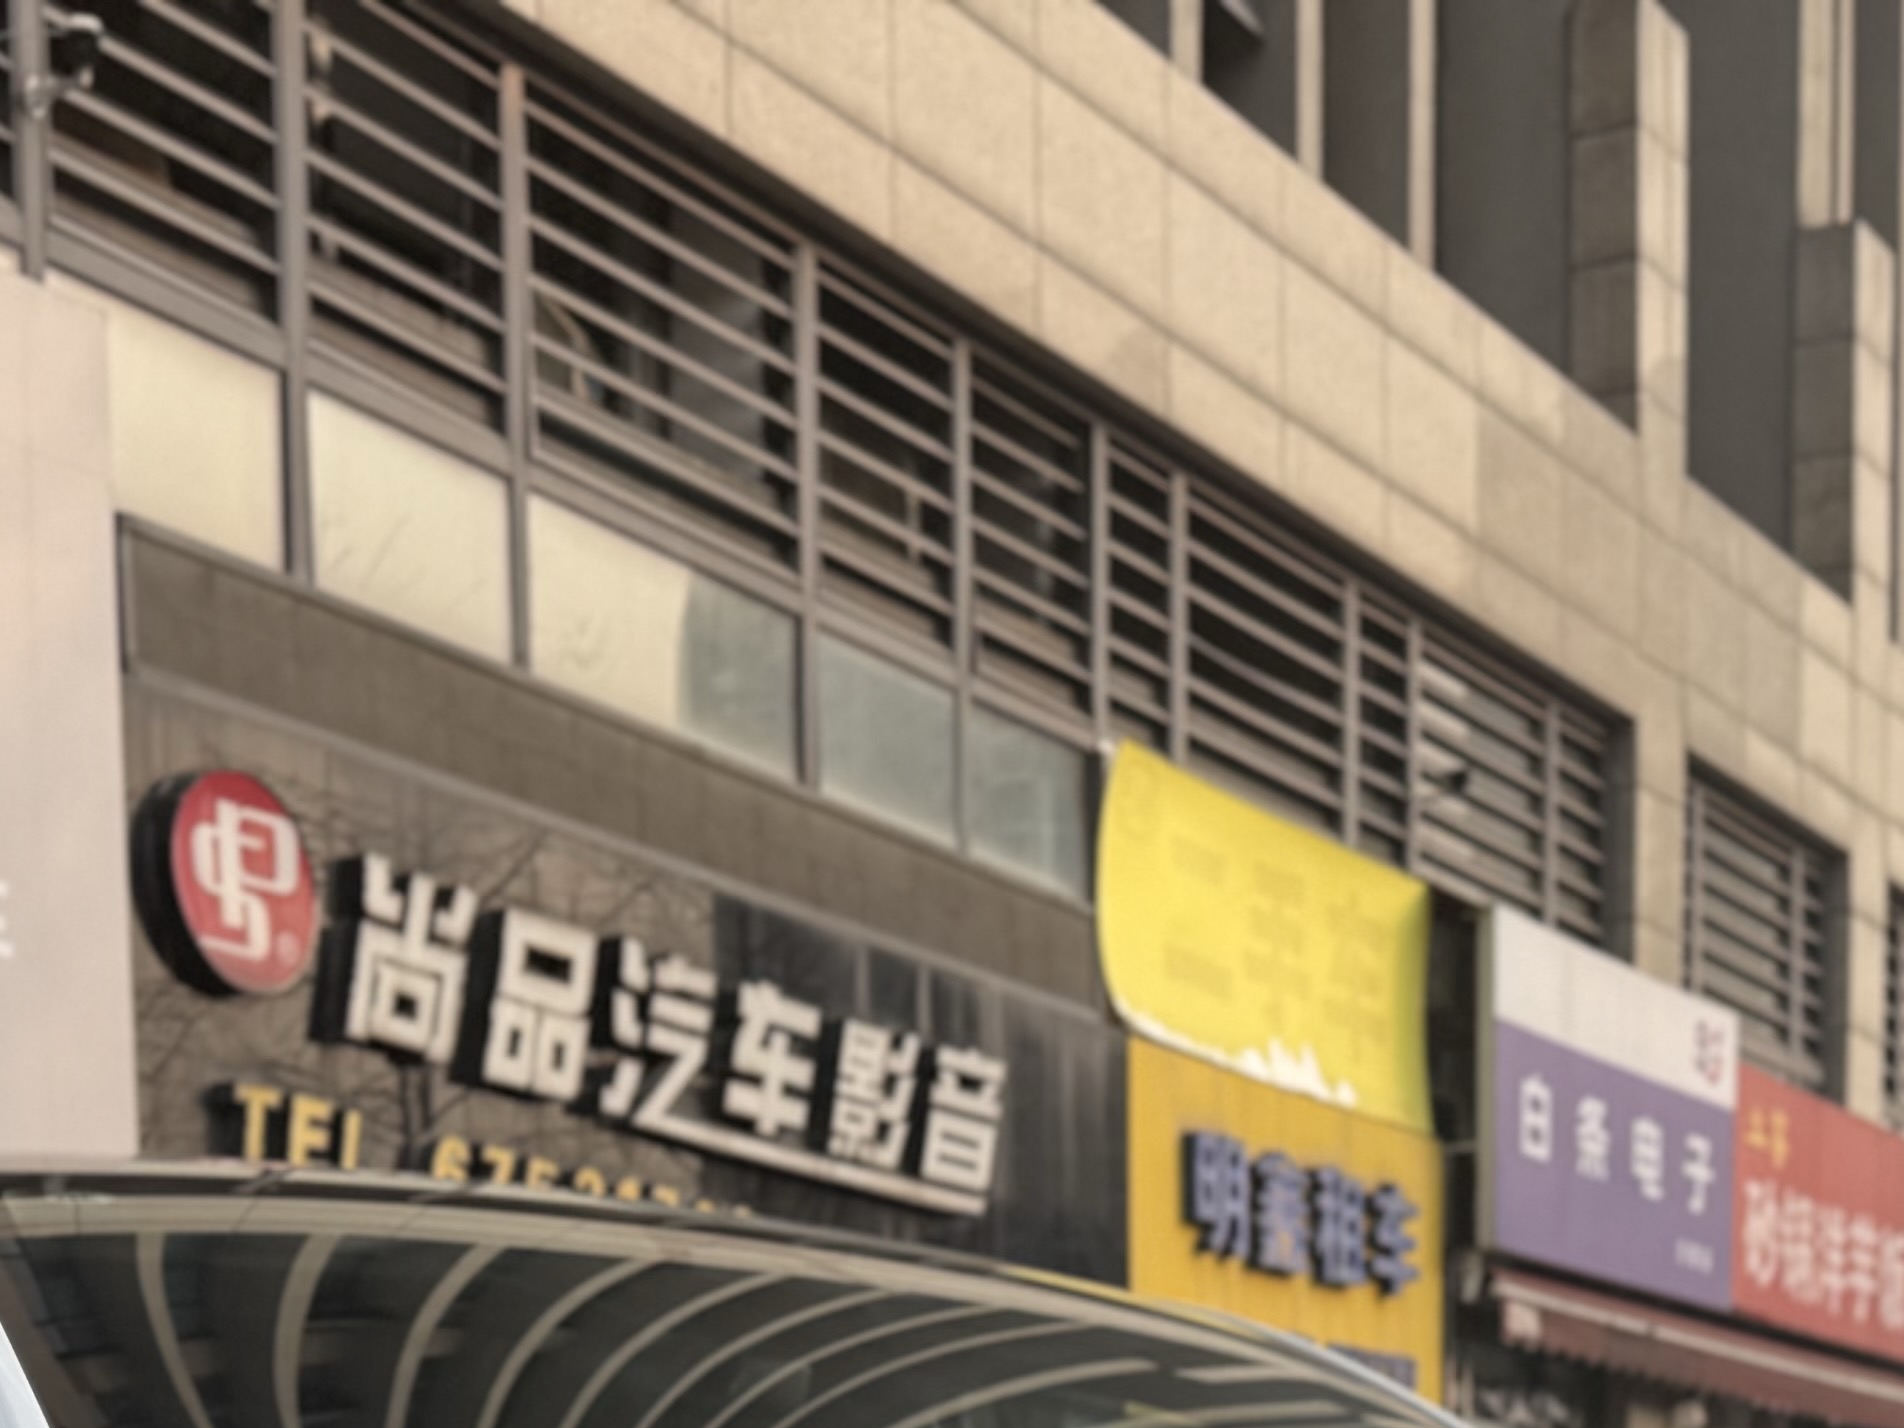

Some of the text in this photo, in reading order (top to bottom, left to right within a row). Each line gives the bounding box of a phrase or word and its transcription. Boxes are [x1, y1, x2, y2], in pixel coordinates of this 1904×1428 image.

[343, 851, 1006, 1215] 尚品汽车影音
